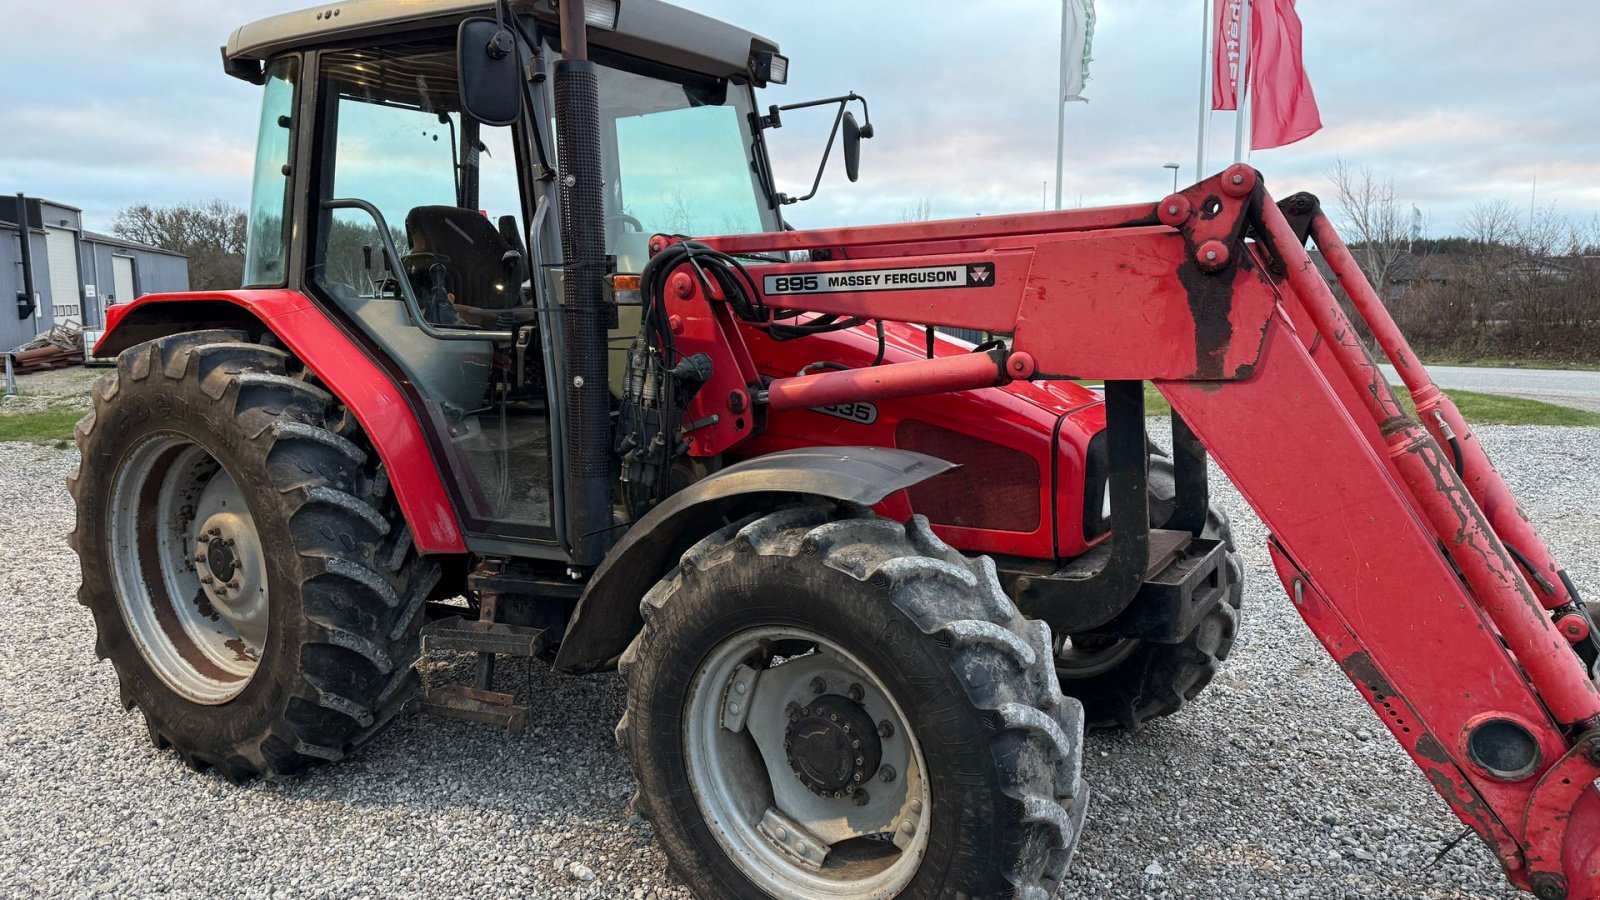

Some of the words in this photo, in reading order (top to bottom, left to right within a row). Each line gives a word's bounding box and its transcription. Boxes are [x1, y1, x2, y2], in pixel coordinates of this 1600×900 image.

[775, 276, 818, 292] 895
[828, 275, 880, 288] MASSEY
[885, 270, 957, 285] FERGUSON
